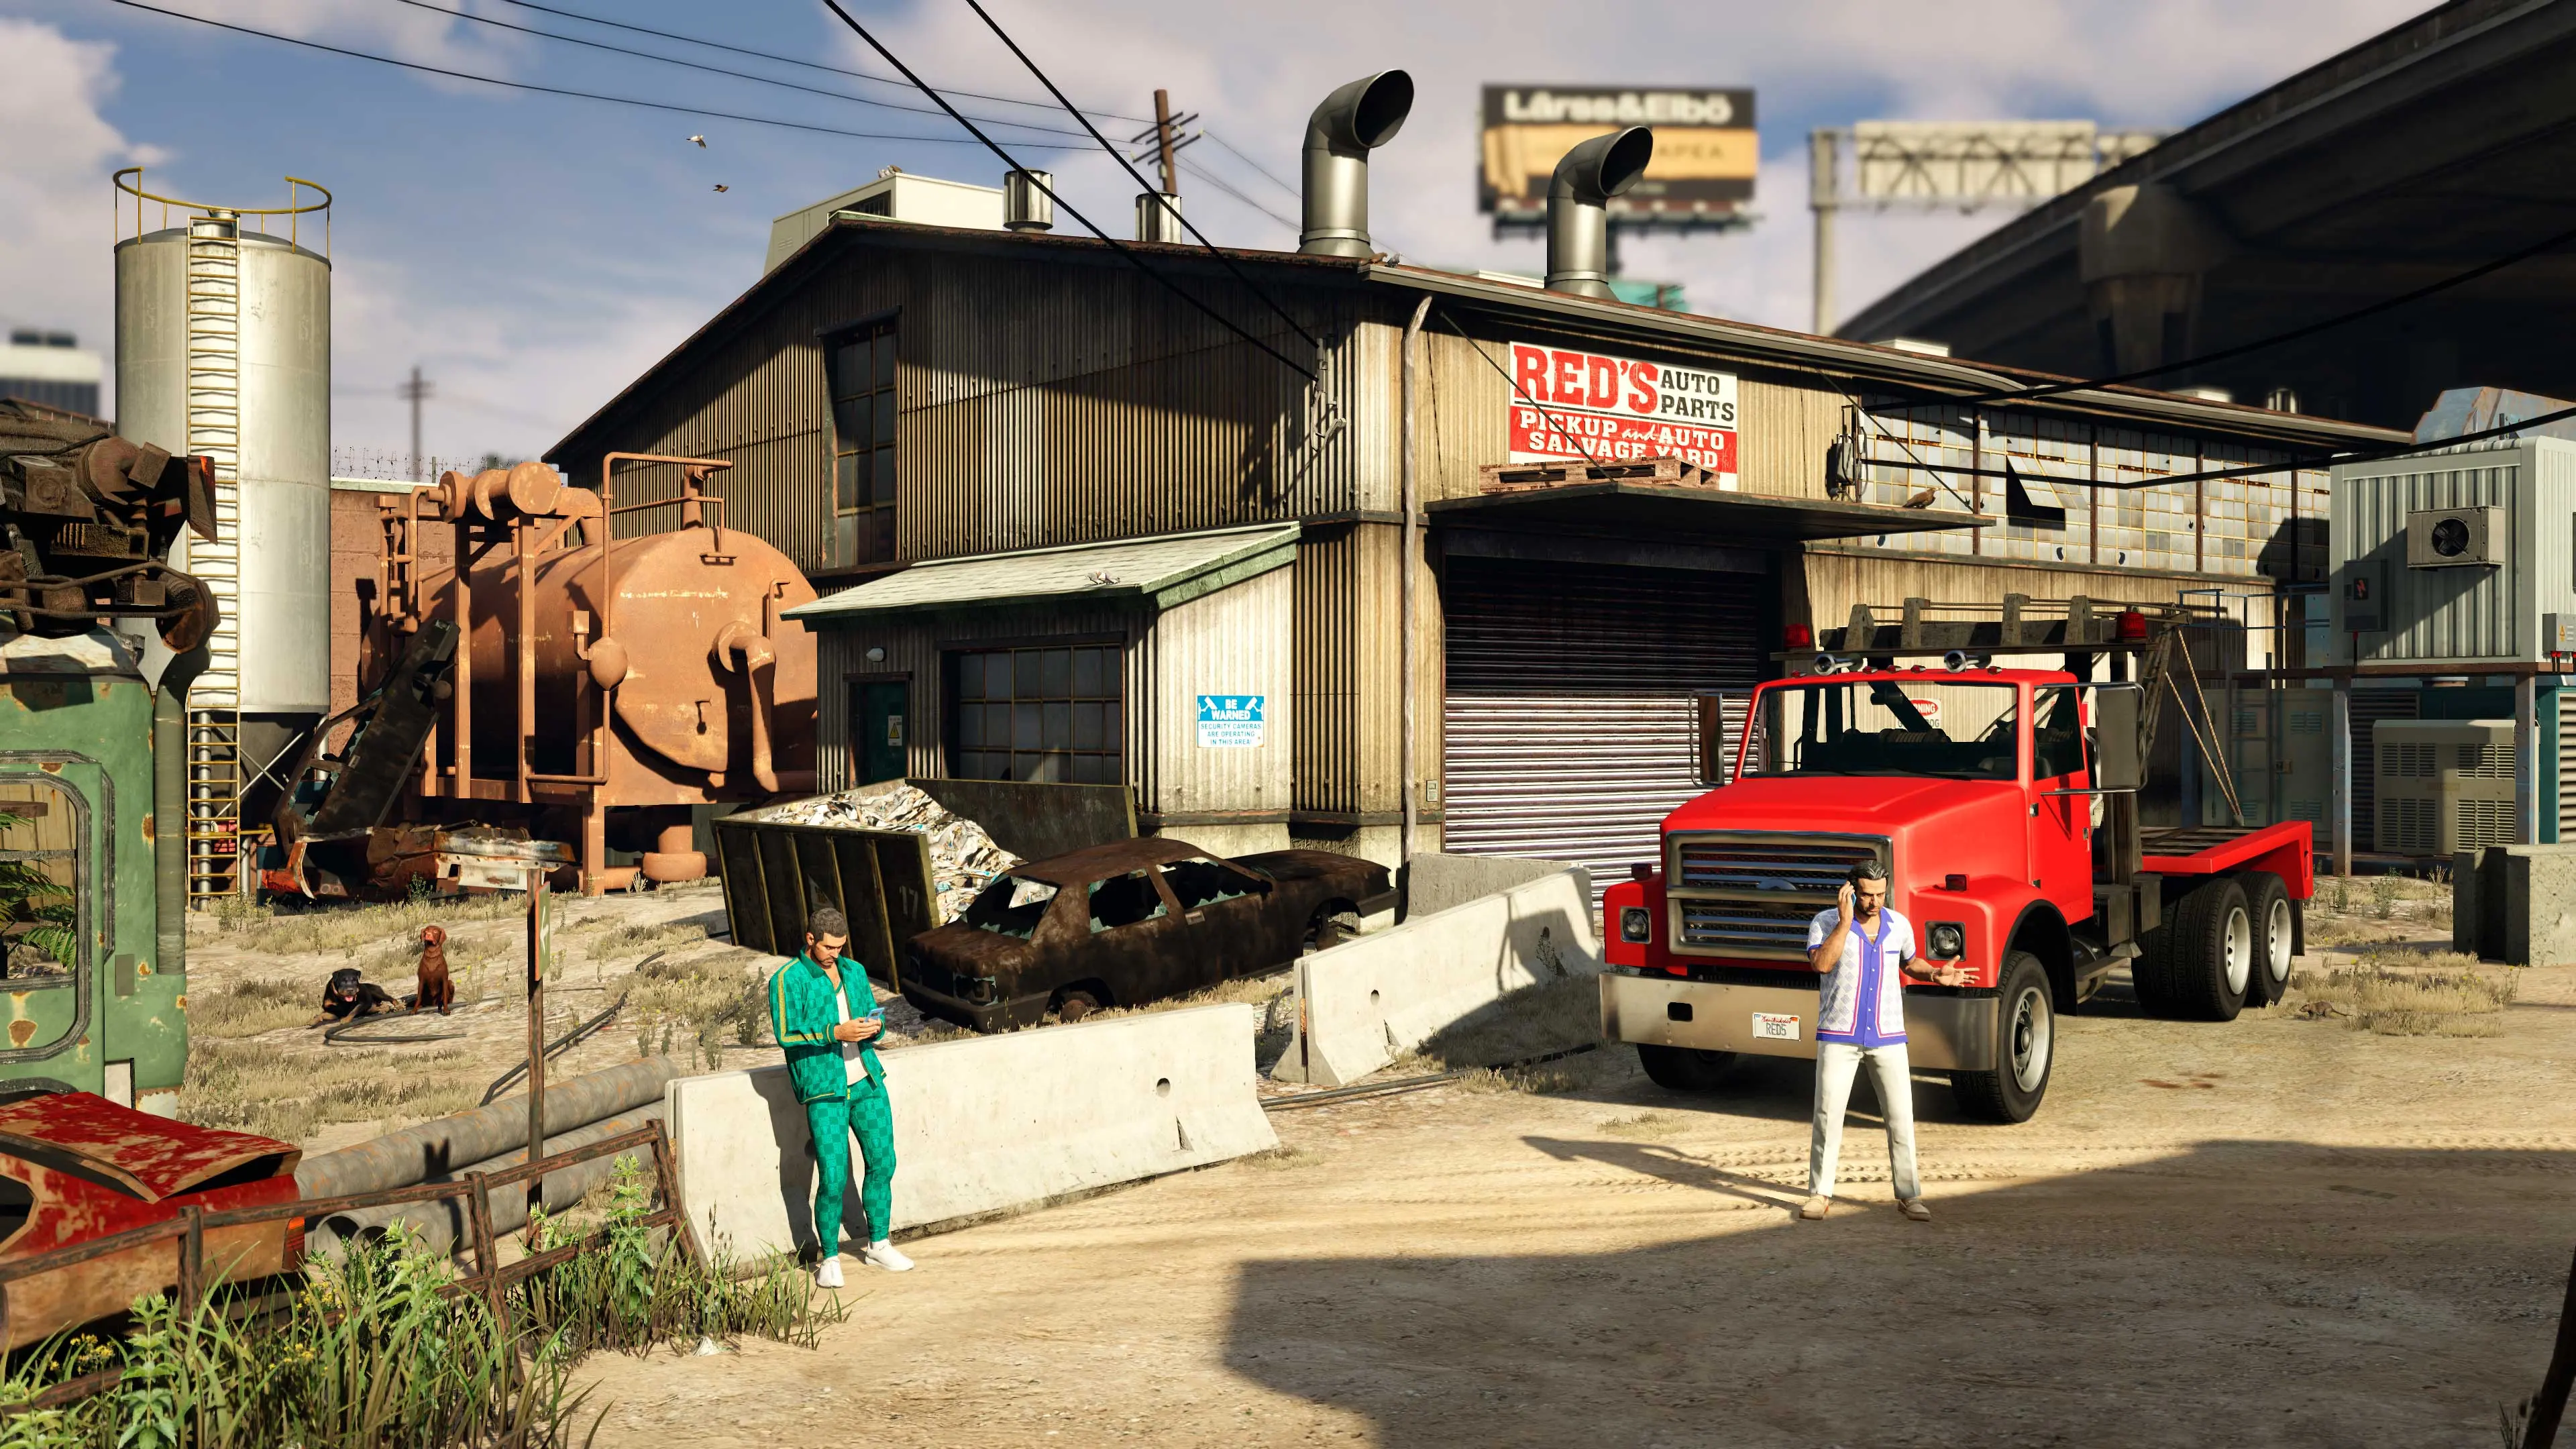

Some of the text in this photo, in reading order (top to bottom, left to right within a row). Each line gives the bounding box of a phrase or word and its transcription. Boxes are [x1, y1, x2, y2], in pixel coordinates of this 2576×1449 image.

[1513, 345, 1658, 414] RED'S
[1660, 370, 1720, 395] AUTO
[1661, 394, 1734, 422] PARTS
[1520, 410, 1724, 450] PICKUP and AUTO
[1529, 431, 1717, 468] SALVAGE YARD
[1212, 710, 1250, 720] WARNED
[1225, 699, 1238, 709] BE
